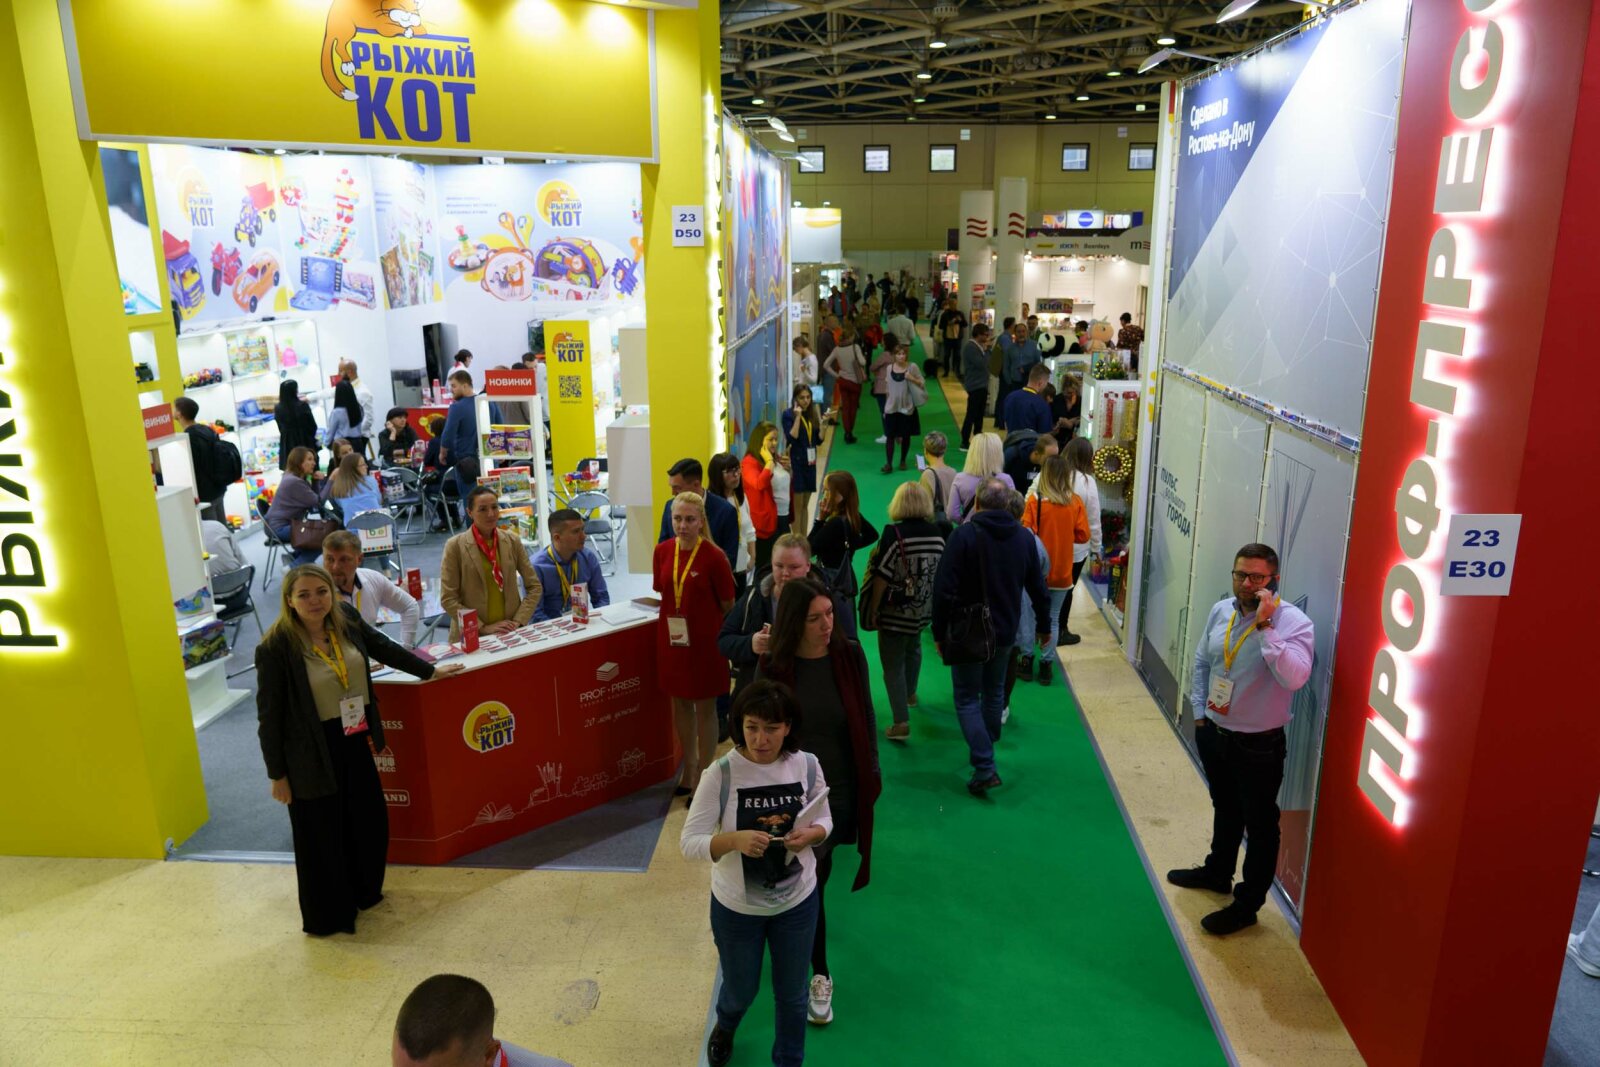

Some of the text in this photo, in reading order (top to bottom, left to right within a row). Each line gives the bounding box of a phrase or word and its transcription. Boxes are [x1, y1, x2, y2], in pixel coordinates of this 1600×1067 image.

[351, 41, 476, 79] РЫЖИЙ
[354, 75, 476, 143] КОТ
[1190, 100, 1222, 131] Сделано
[1188, 120, 1255, 156] Ростове-на-Дону
[550, 201, 582, 210] РЫЖИЙ
[190, 207, 214, 226] КОТ
[551, 211, 582, 226] КОТ
[679, 213, 697, 223] 23
[675, 228, 702, 239] D50
[558, 350, 584, 362] КОТ
[489, 378, 532, 387] НОВИНКИ
[143, 413, 171, 429] ВИНКИ
[1357, 0, 1504, 824] ПРОФ-ПРЕС
[1167, 502, 1191, 538] ГОРОДА
[1462, 529, 1500, 547] 23
[1448, 561, 1506, 578] E30
[580, 686, 606, 702] PROF
[612, 677, 640, 693] PRESS
[381, 720, 404, 729] RESS
[479, 717, 514, 735] РЫЖИЙ
[480, 726, 514, 751] КОТ
[383, 794, 407, 802] AND
